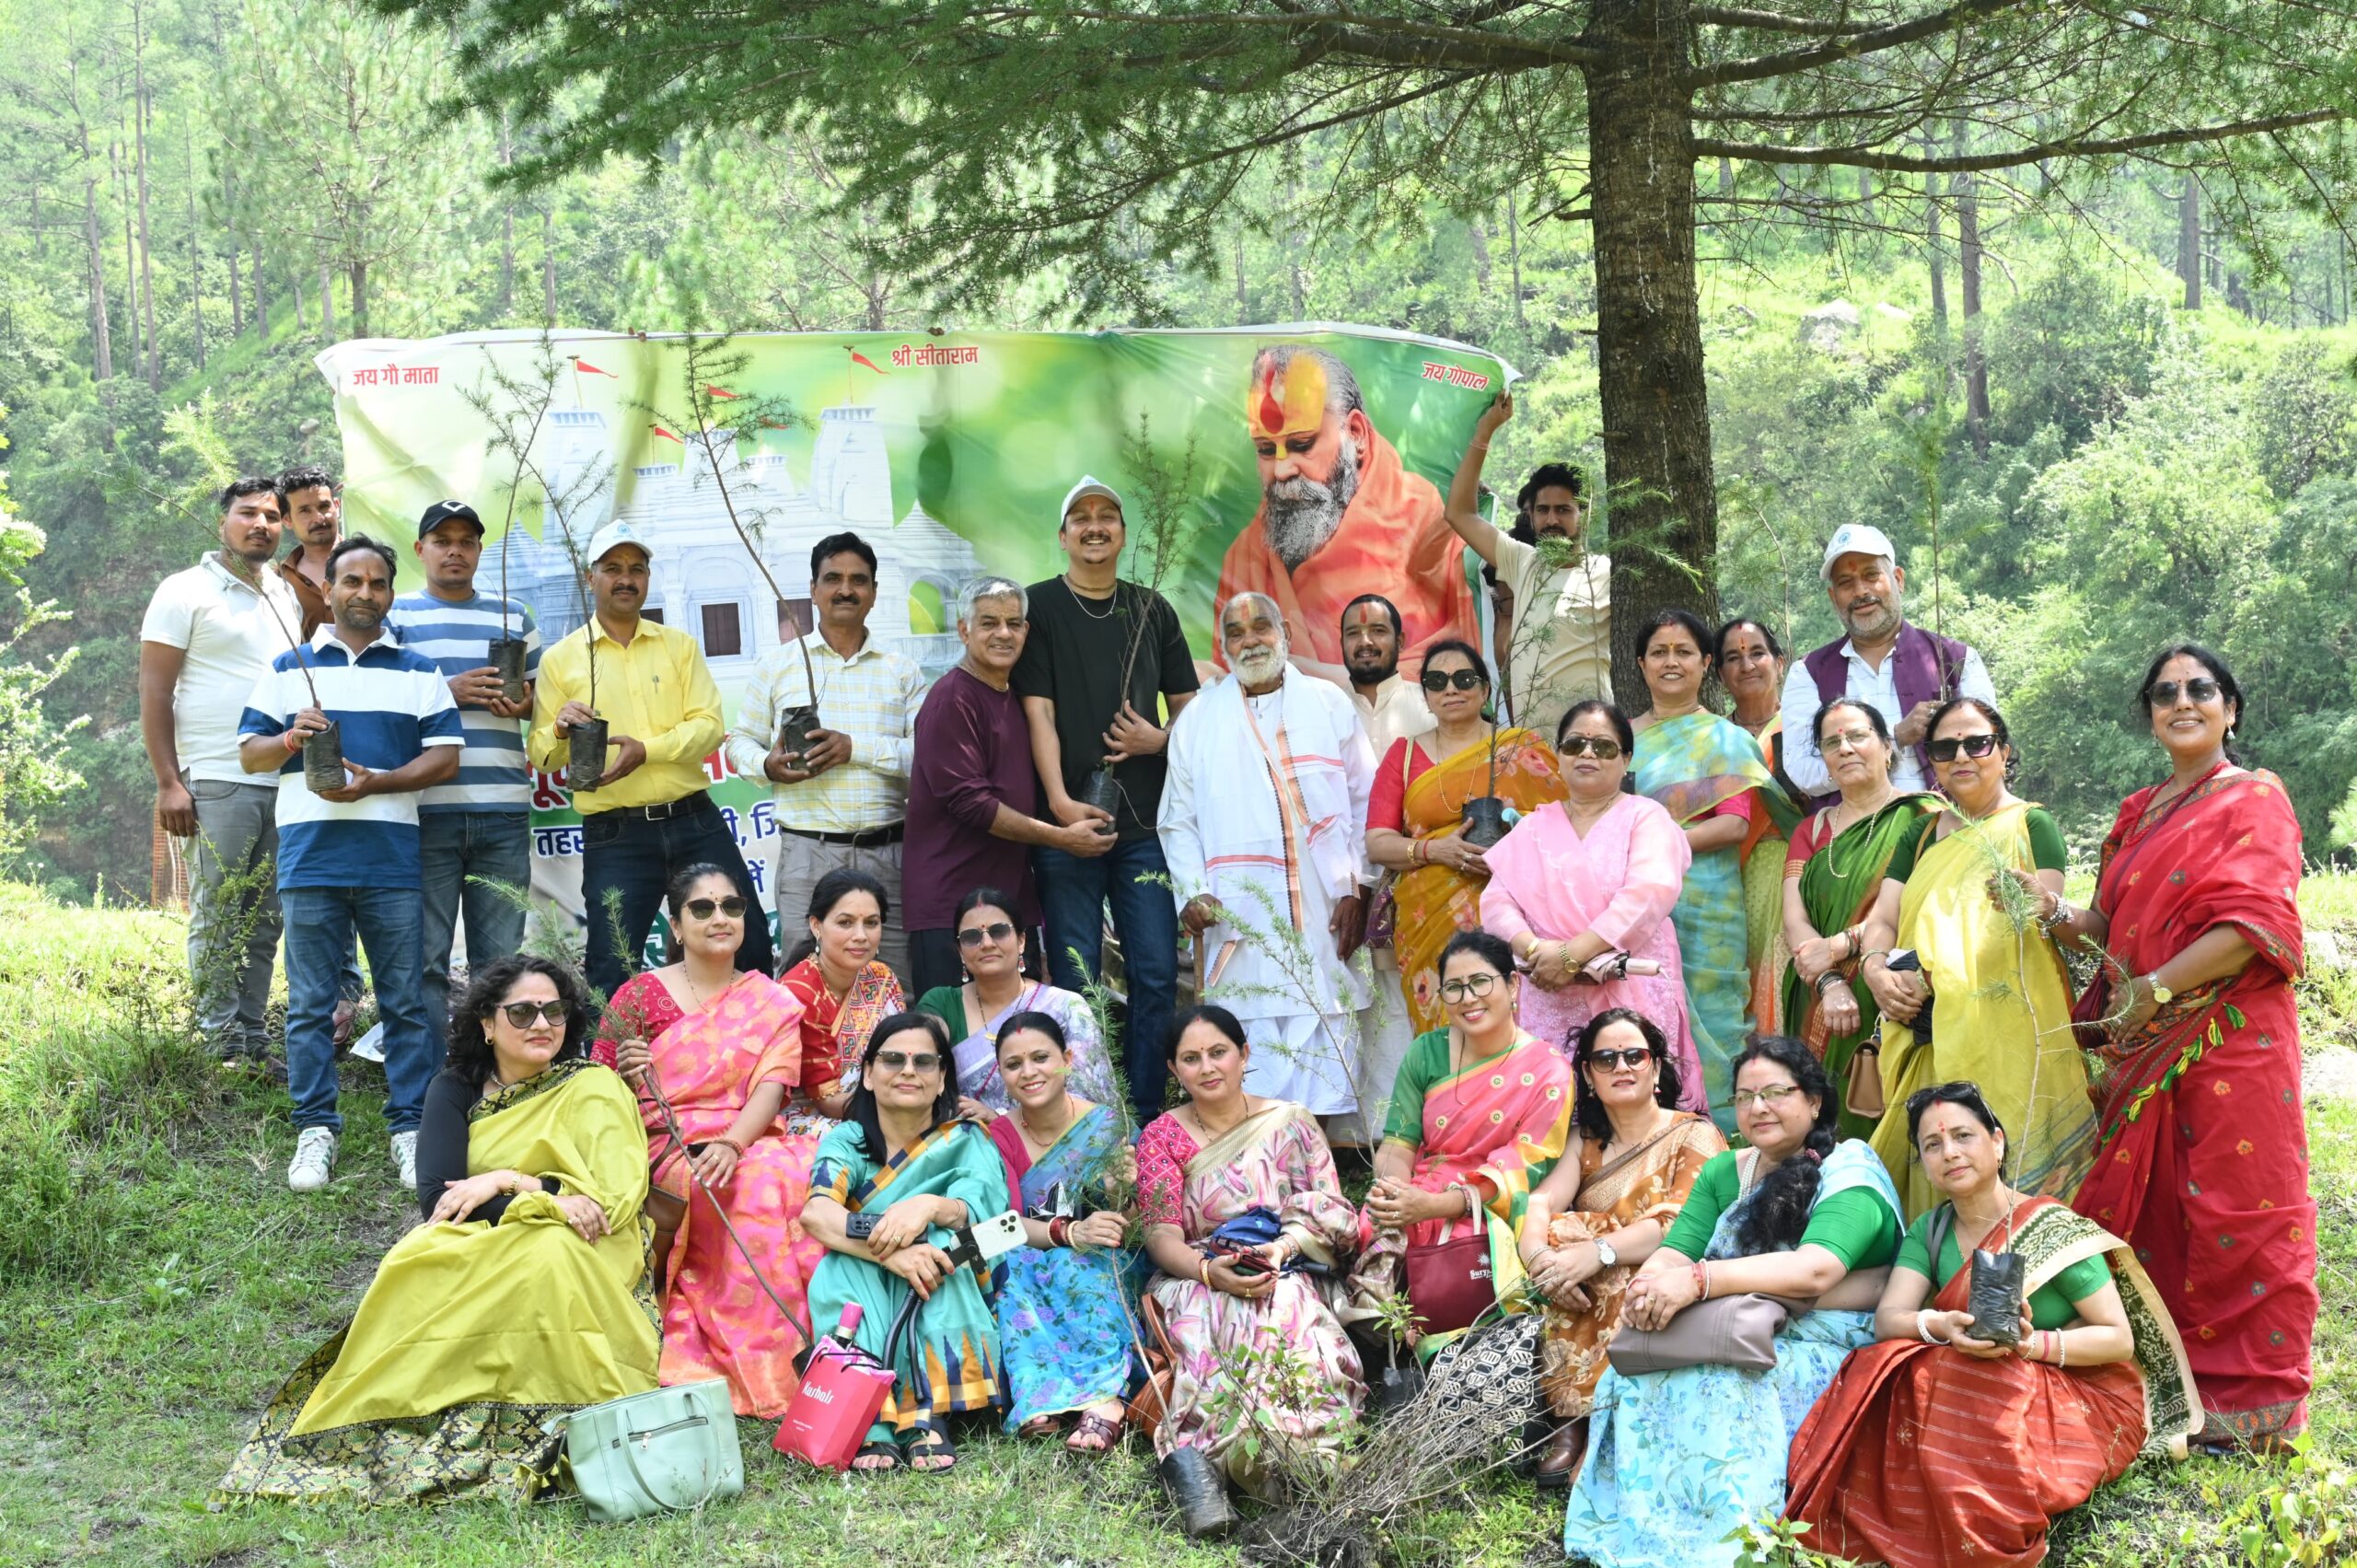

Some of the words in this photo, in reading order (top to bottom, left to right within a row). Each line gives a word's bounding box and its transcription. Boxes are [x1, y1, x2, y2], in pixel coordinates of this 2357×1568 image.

[891, 344, 911, 366] श्री
[914, 343, 979, 365] सीताराम
[353, 369, 378, 386] जय
[380, 363, 400, 385] गौ
[401, 366, 440, 384] माता
[1422, 362, 1446, 381] जय
[1446, 365, 1488, 389] गोपाल
